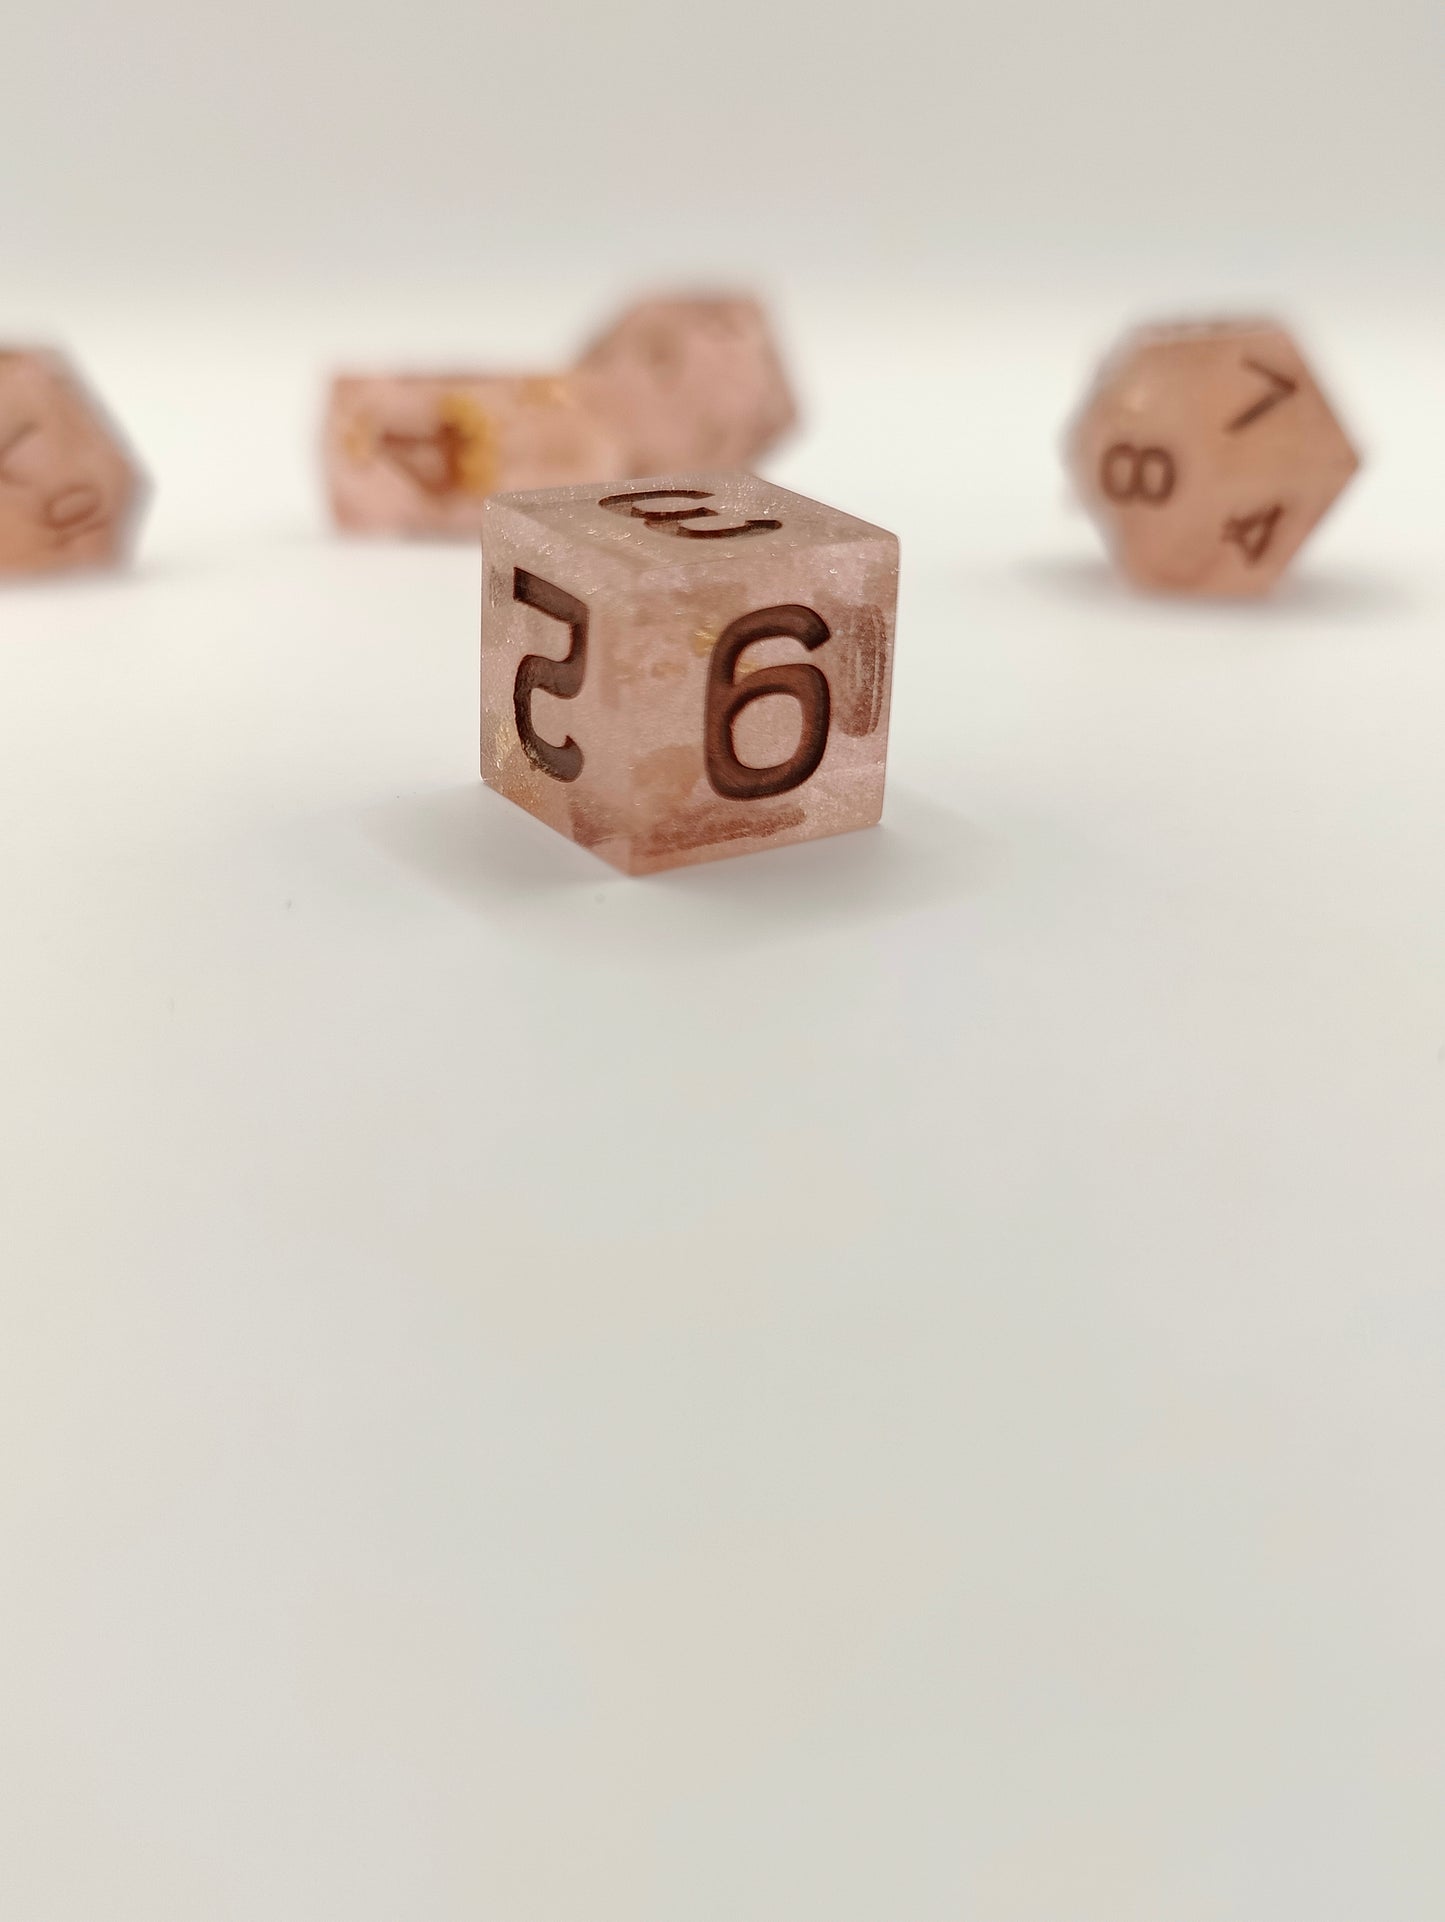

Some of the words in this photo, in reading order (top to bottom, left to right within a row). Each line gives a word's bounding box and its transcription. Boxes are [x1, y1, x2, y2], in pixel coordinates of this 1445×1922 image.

[1100, 443, 1176, 506] 8
[598, 489, 783, 539] 3
[704, 604, 831, 801] 6
